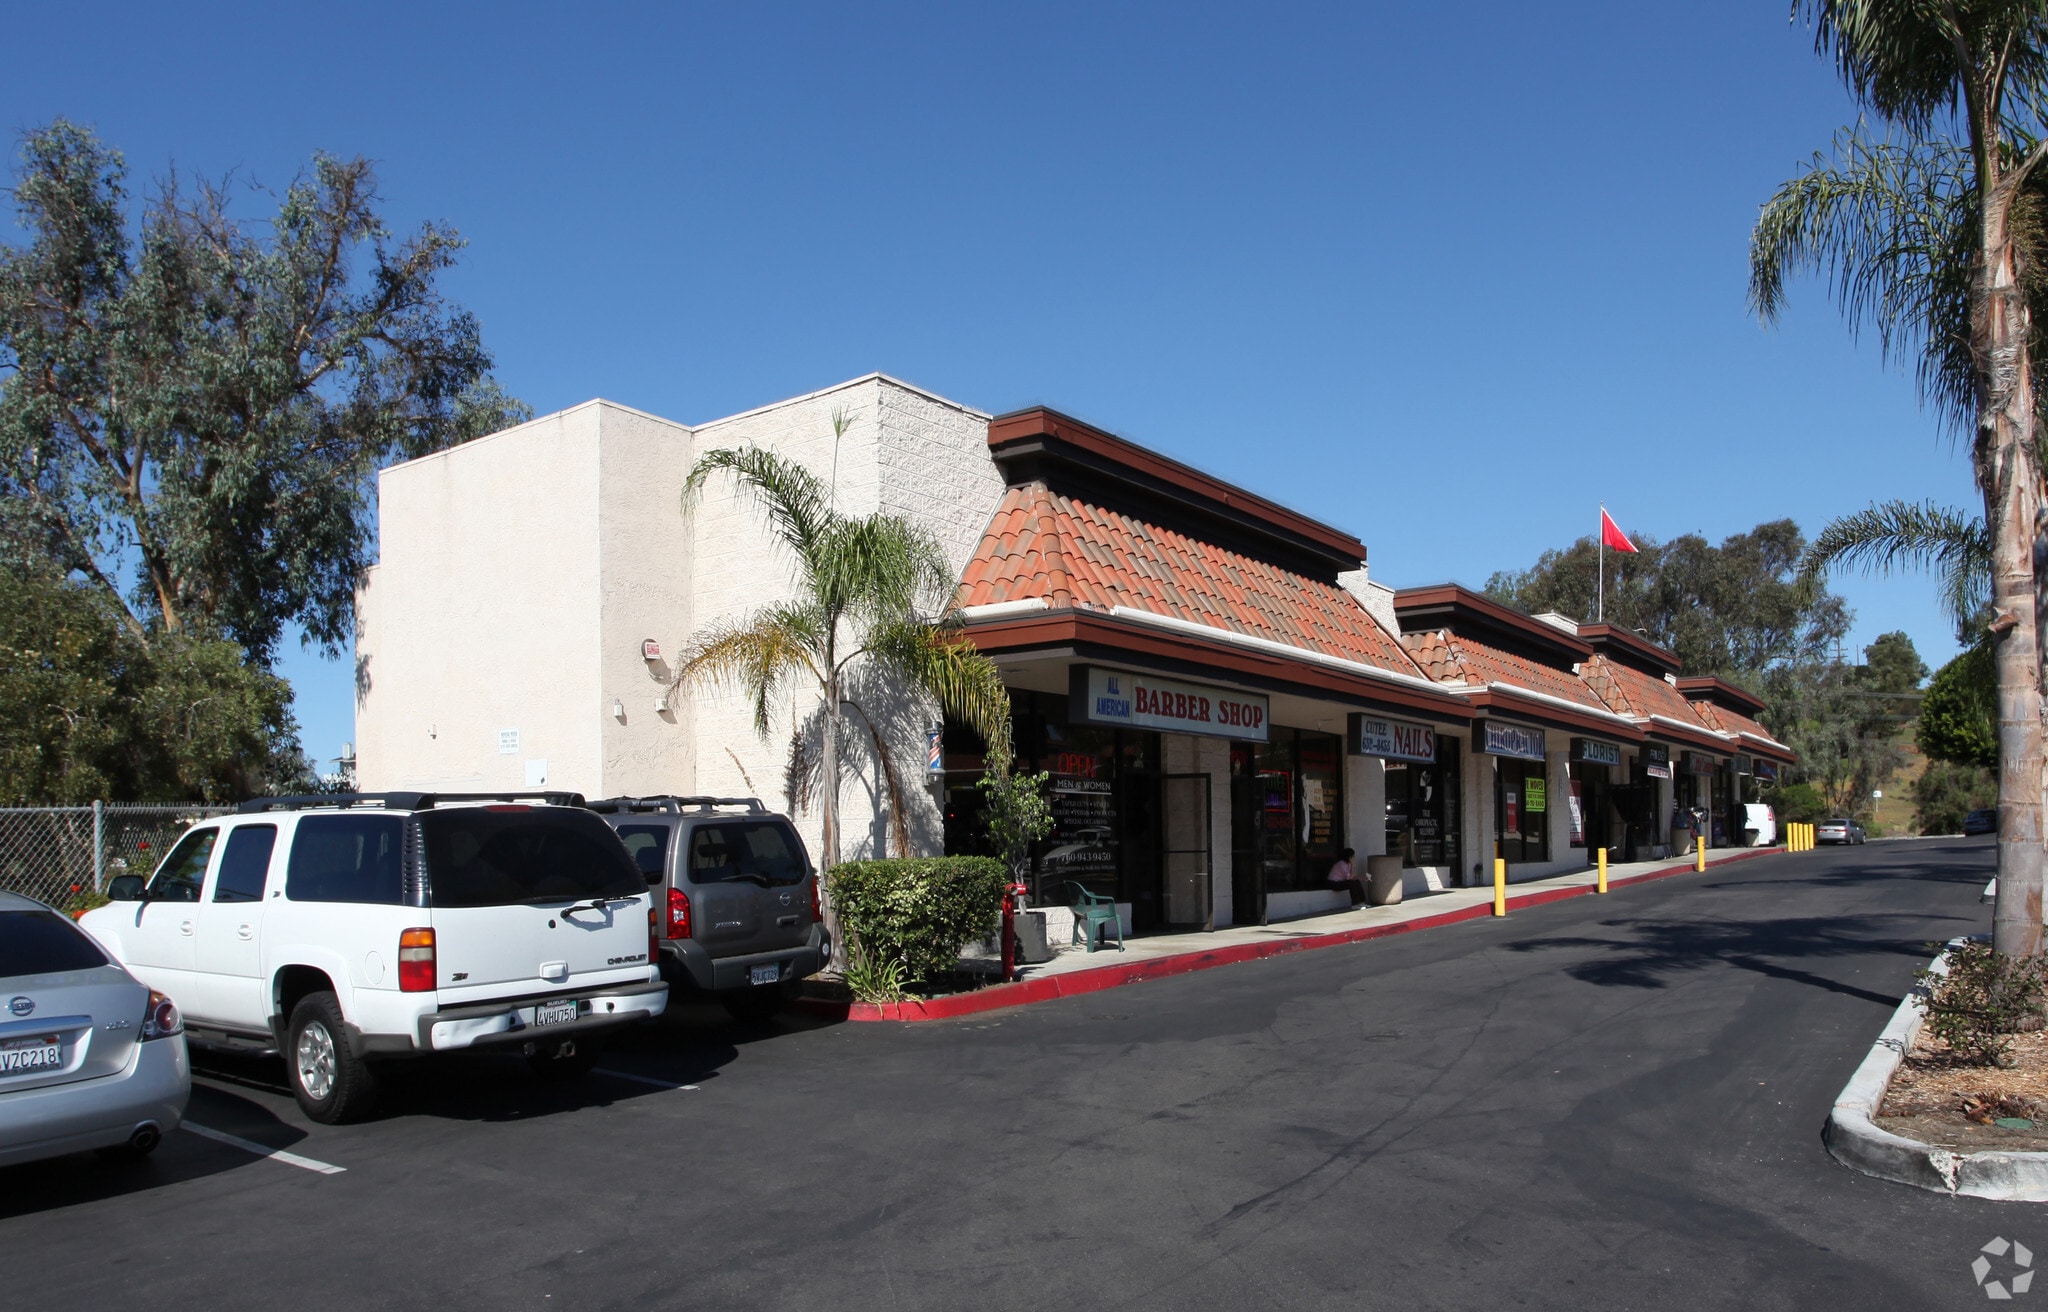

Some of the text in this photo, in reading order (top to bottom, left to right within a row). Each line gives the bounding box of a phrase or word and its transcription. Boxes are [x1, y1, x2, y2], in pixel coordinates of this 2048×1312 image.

[1107, 677, 1119, 695] ALL
[1096, 697, 1130, 718] AMERICAN
[1135, 686, 1263, 729] BARBER SHOP
[1365, 720, 1387, 737] CUTEE
[1393, 724, 1433, 758] NAILS
[1486, 723, 1544, 756] CHIROPRACTOR
[1583, 740, 1619, 763] FLORIST
[1058, 751, 1097, 779] OPEN
[1057, 780, 1074, 788] MEN
[1084, 781, 1111, 791] WOMEN
[1061, 852, 1111, 863] 760-943-9450
[606, 954, 648, 966] CHEVROLET
[538, 1007, 576, 1026] 4VHU750
[0, 1048, 57, 1070] VZC218
